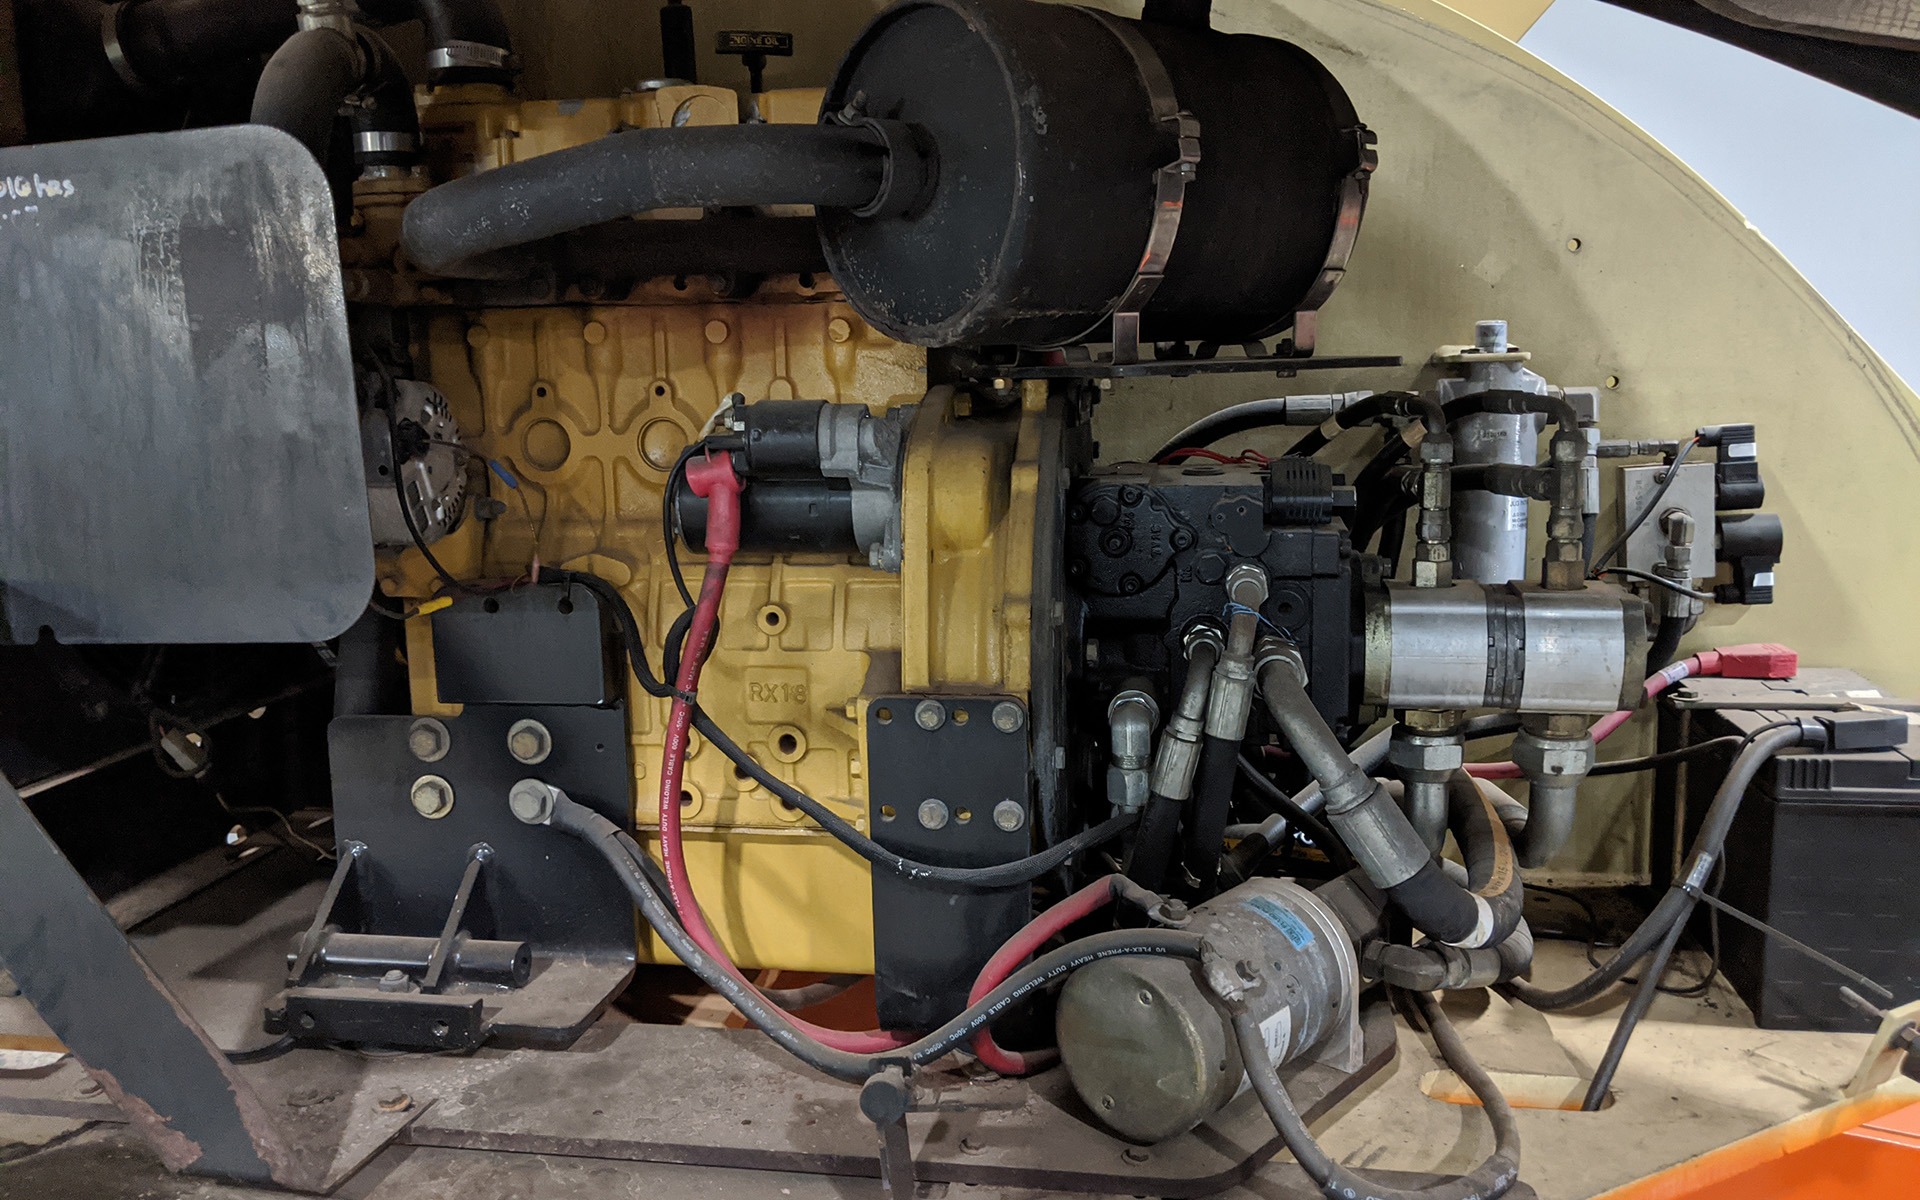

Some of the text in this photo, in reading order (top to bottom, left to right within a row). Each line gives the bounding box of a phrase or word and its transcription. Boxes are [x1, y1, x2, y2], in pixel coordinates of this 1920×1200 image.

[749, 682, 807, 705] RX18
[662, 779, 672, 810] WELDING
[667, 753, 676, 776] CABLE
[1070, 954, 1094, 968] HEAVY
[1096, 946, 1152, 959] FLEX-A-PRENE
[1048, 965, 1067, 979] DUTY
[1012, 976, 1046, 998] WELDING
[987, 996, 1011, 1016] CABLE
[970, 1013, 987, 1028] 600V
